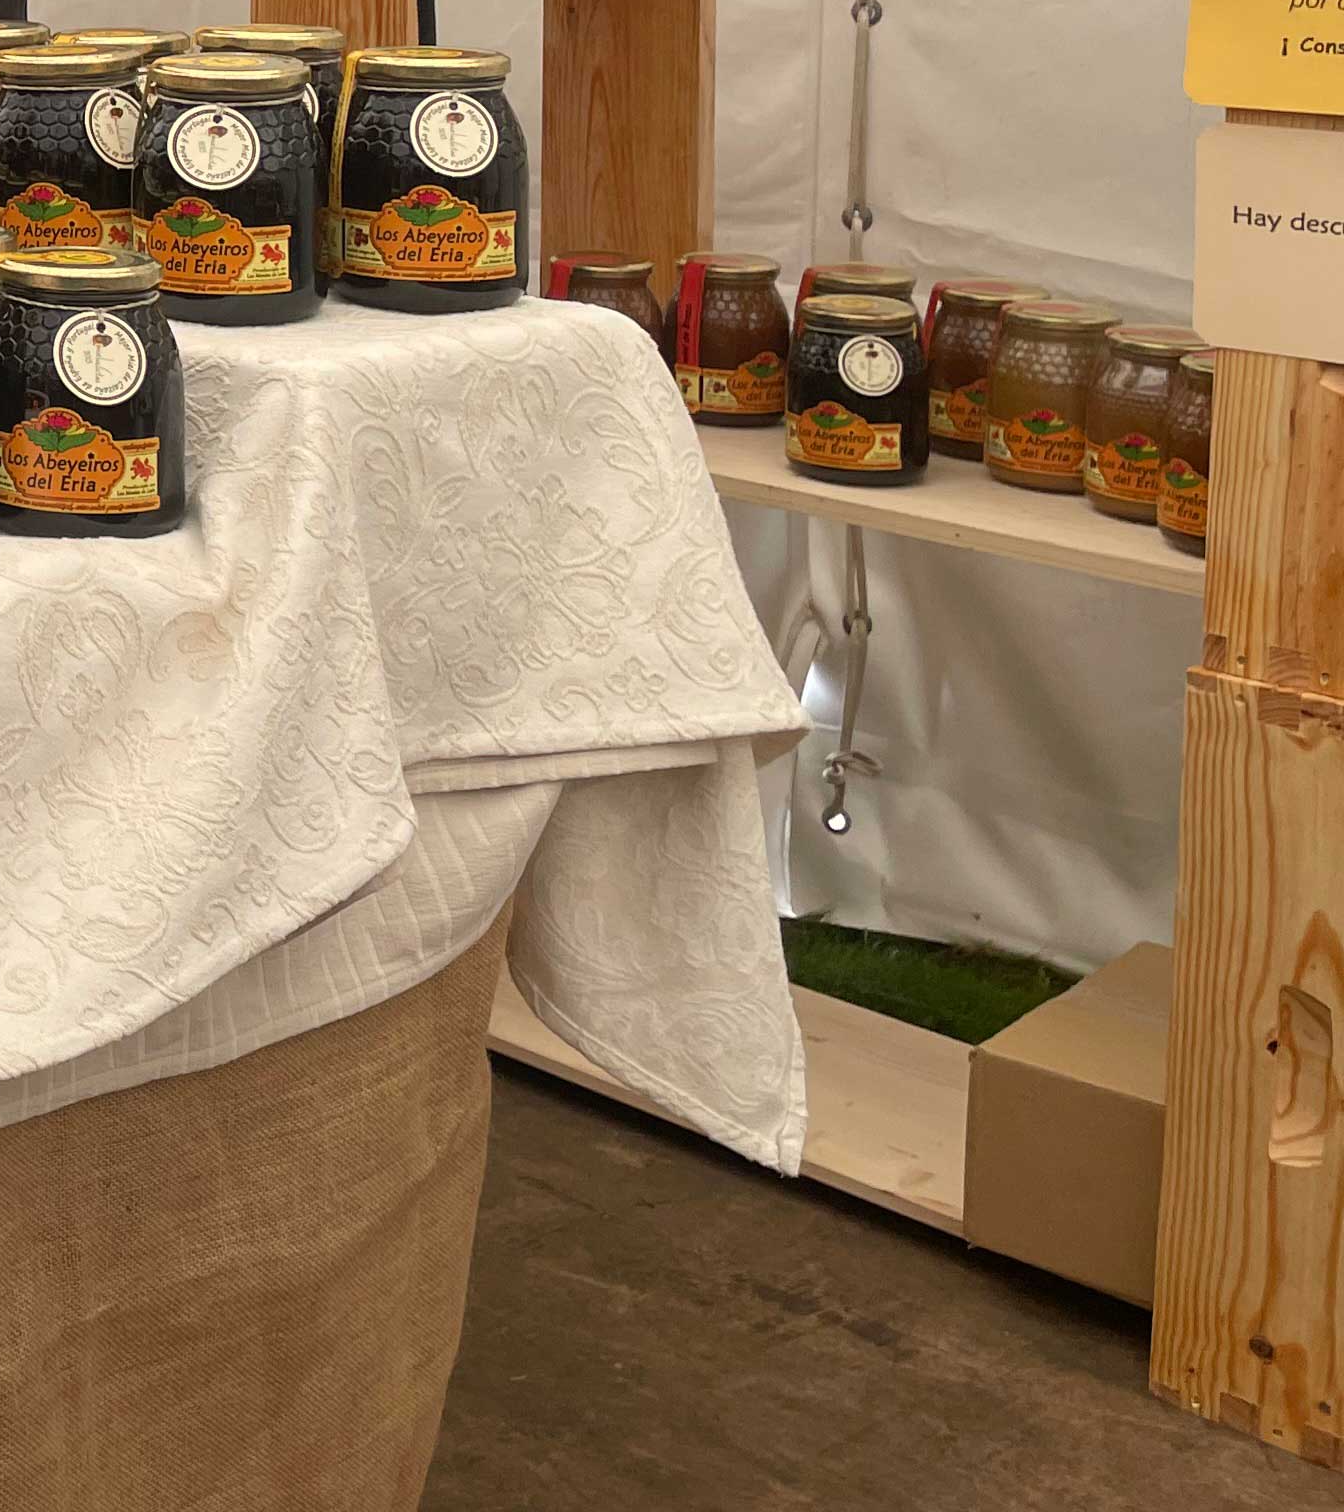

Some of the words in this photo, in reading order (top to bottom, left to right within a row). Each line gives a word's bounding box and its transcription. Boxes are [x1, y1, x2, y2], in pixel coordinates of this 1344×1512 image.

[1233, 205, 1282, 232] Hay
[1290, 212, 1344, 236] desc
[24, 221, 97, 244] Abeyeiros
[375, 226, 398, 242] Los
[402, 226, 485, 248] Abeyeiros
[150, 237, 168, 252] Los
[170, 238, 249, 262] Abeyeiros
[397, 245, 424, 261] del
[429, 247, 464, 263] Eria
[166, 256, 187, 272] del
[193, 259, 227, 275] Eria
[7, 449, 29, 466] Los
[33, 452, 120, 476] Abeyeiros
[26, 473, 52, 489] del
[61, 475, 96, 492] Eria
